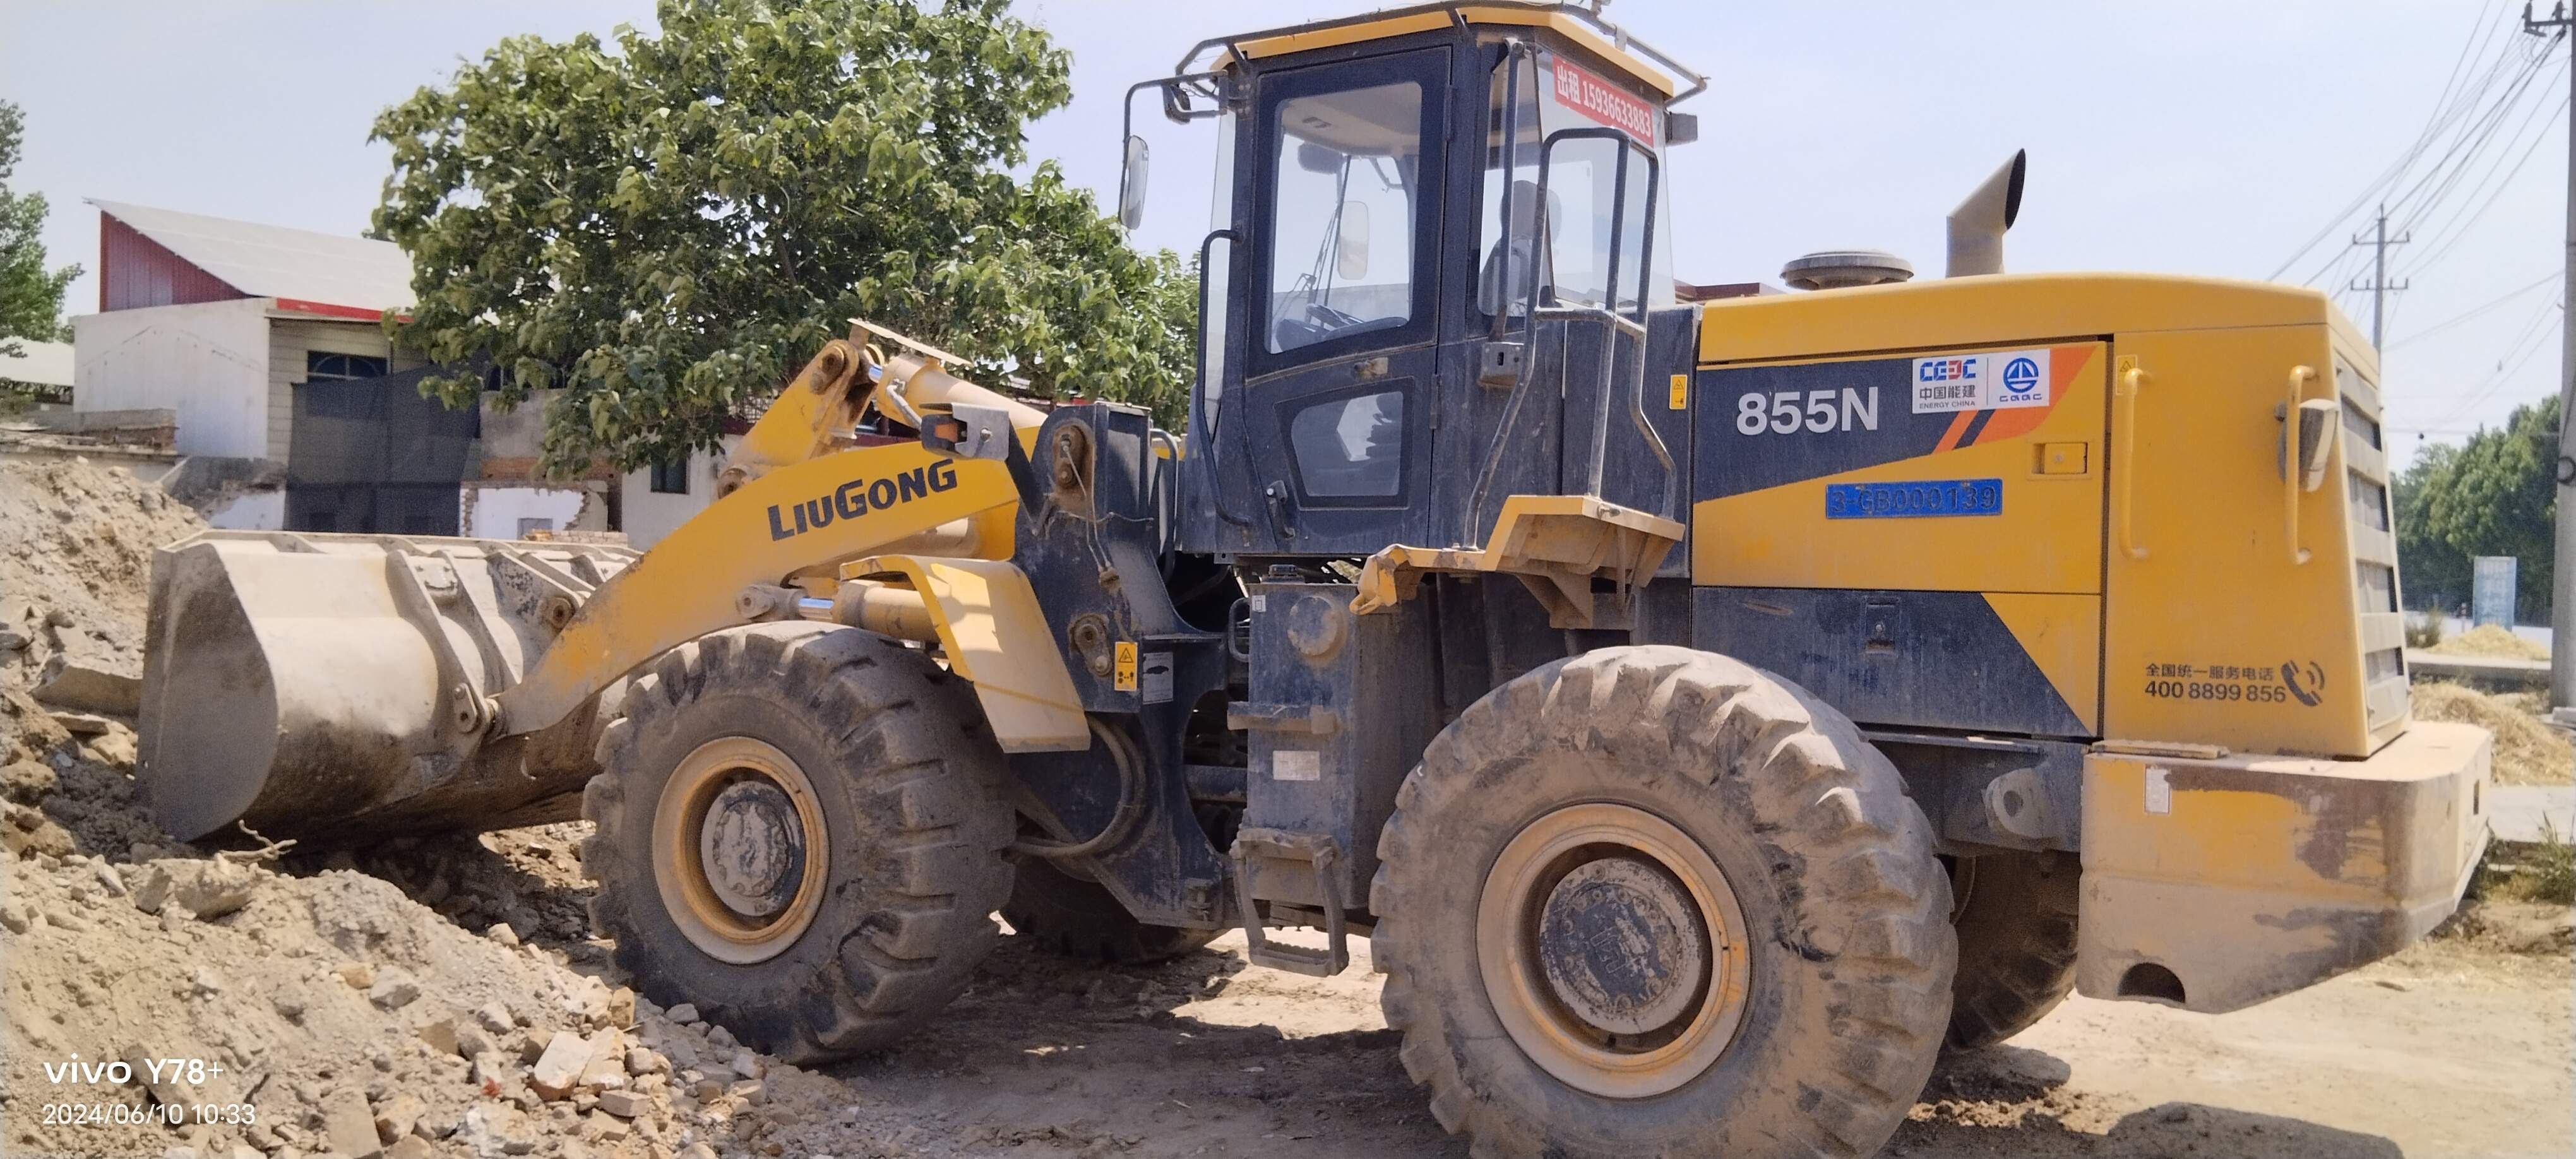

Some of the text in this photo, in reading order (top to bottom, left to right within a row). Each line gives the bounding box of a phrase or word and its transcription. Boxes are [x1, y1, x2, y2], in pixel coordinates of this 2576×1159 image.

[1557, 64, 1651, 138] 出租 15936633883
[1919, 384, 1976, 400] 中国能建
[1737, 387, 1878, 436] 855N
[1832, 486, 1996, 512] 3-GB000139
[2146, 663, 2274, 681] 全国统一服务电话
[2145, 681, 2286, 703] 400 8899 856
